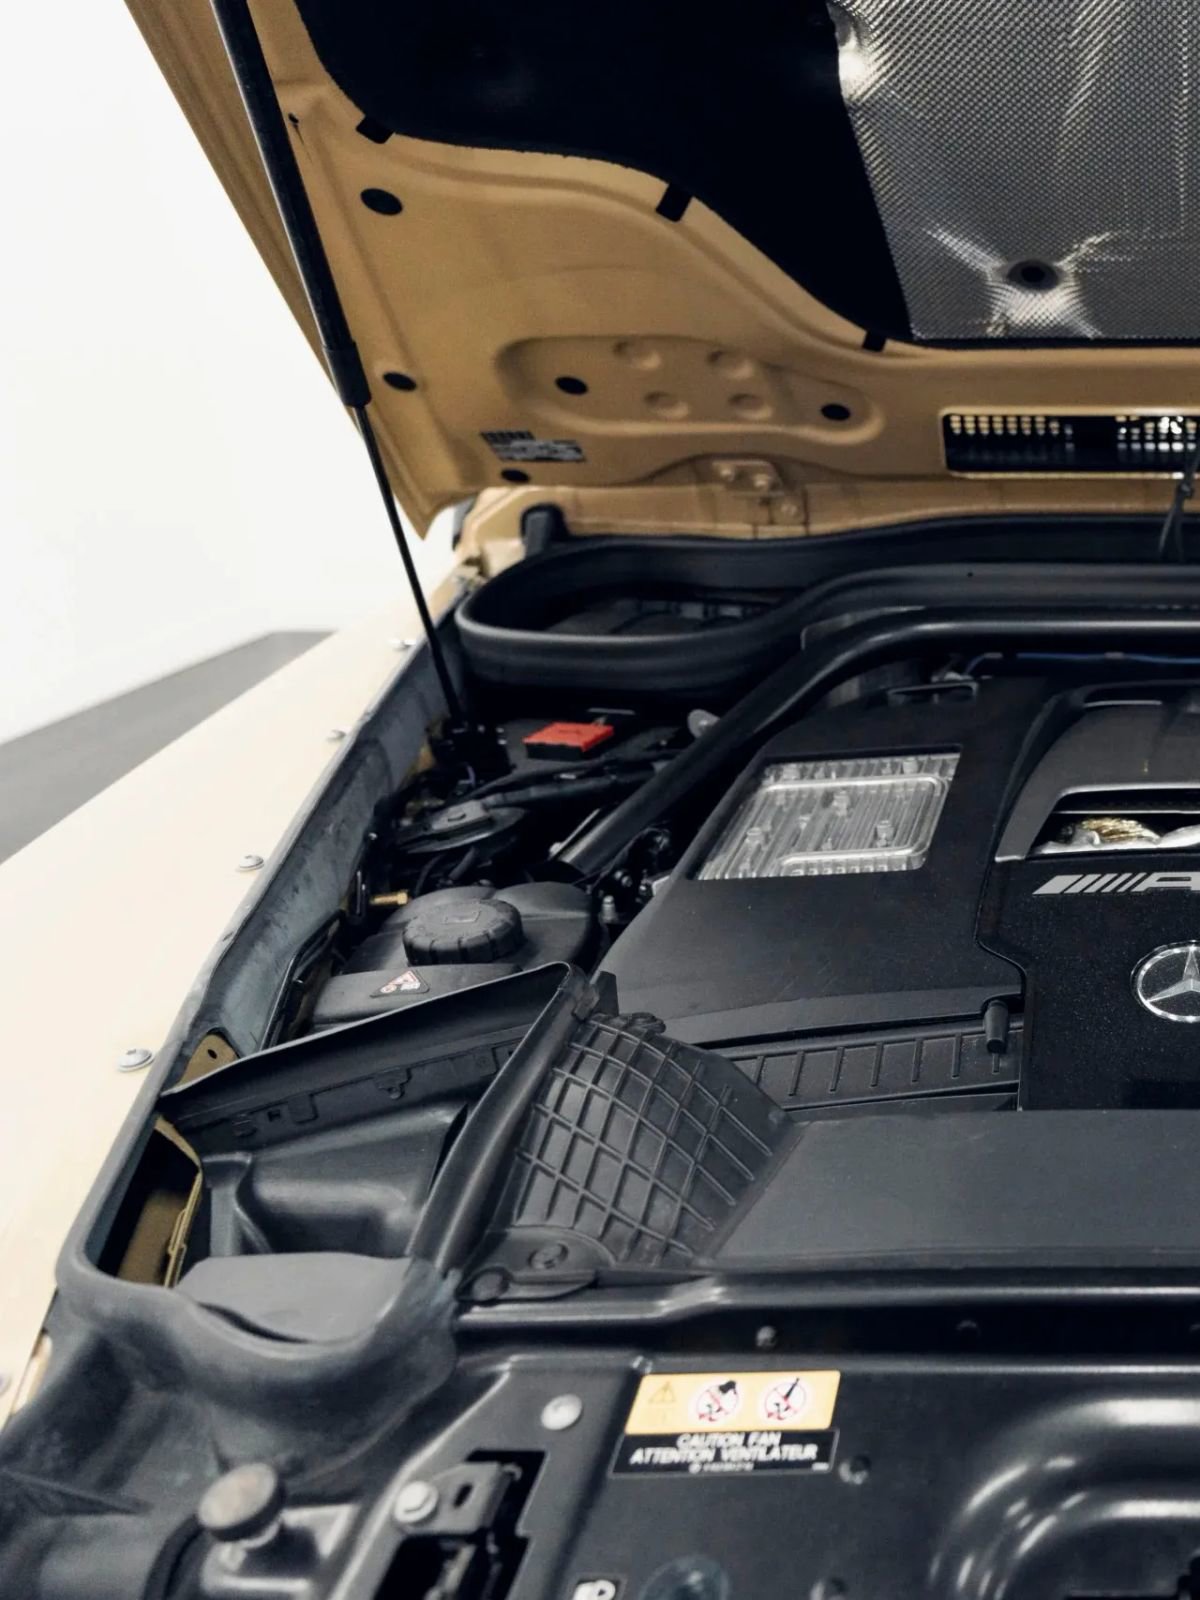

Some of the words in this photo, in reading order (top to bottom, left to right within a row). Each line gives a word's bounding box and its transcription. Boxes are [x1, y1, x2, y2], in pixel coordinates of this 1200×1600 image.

[676, 1432, 745, 1449] CAUTION
[747, 1431, 782, 1447] FAN
[630, 1447, 715, 1464] ATTENTION
[720, 1444, 818, 1462] VENTILATEUR
